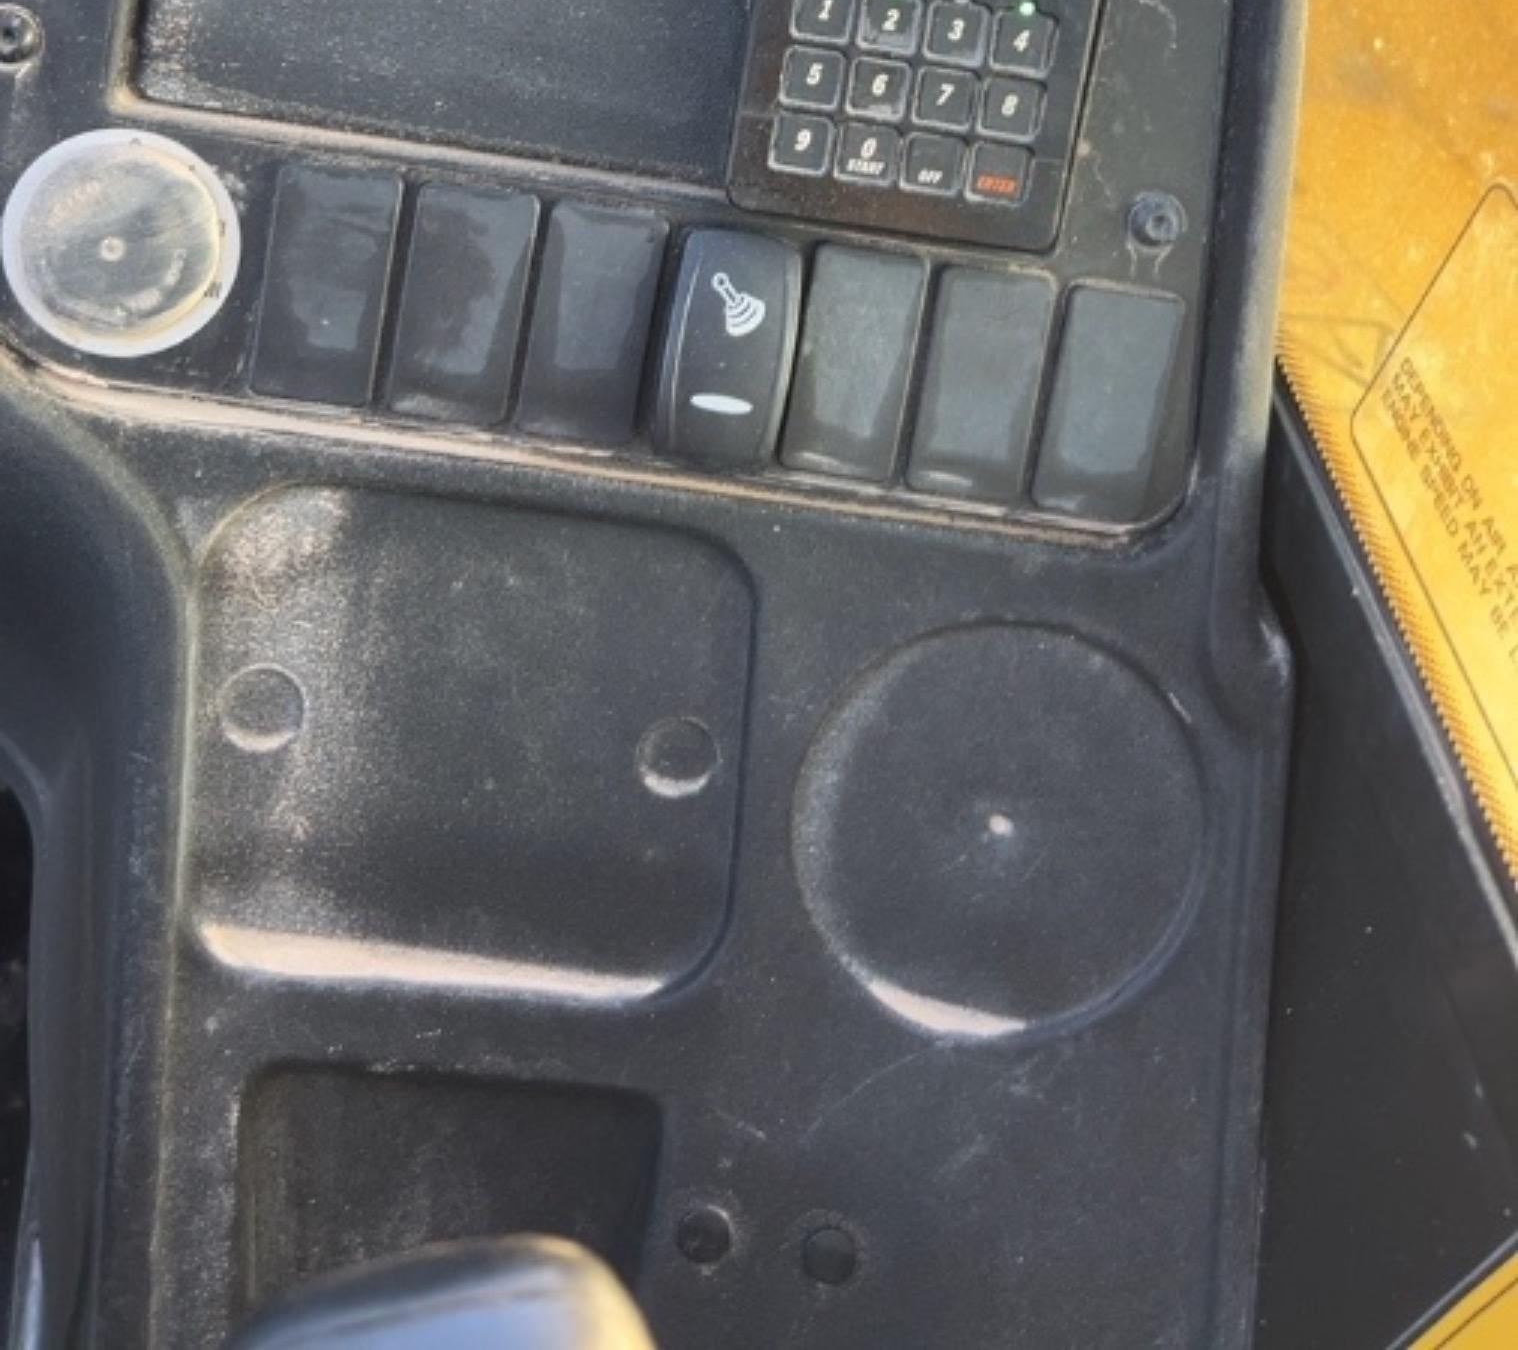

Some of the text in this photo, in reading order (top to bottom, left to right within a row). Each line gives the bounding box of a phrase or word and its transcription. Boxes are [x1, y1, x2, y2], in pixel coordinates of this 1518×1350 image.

[882, 9, 900, 32] 2
[948, 18, 965, 41] 3
[1013, 29, 1030, 52] 4
[806, 62, 823, 85] 5
[872, 74, 889, 97] 6
[936, 83, 955, 106] 7
[1001, 93, 1018, 116] 8
[795, 128, 811, 151] 9
[861, 138, 877, 160] 0
[846, 158, 885, 176] START
[917, 168, 943, 184] OFF
[976, 175, 1017, 193] ENTER
[1457, 539, 1493, 596] MAY
